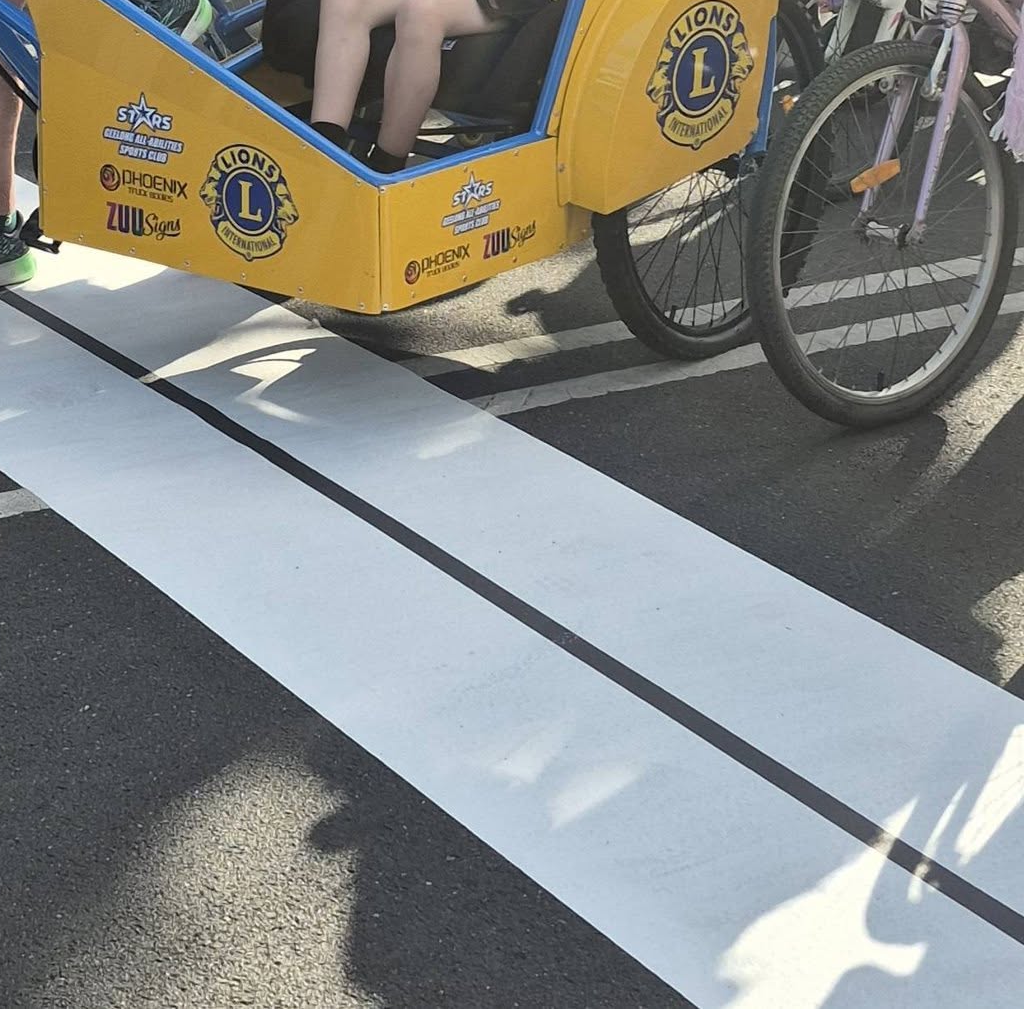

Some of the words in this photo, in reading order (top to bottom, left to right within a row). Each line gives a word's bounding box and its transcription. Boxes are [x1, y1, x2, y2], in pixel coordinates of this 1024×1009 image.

[674, 5, 735, 43] LIONS
[688, 47, 715, 99] L
[669, 107, 729, 138] INTERNATIONAL
[119, 145, 147, 159] SPORTS
[221, 149, 276, 179] LIONS
[122, 169, 188, 200] PHOENIX
[238, 180, 263, 222] L
[106, 201, 144, 237] ZUU
[143, 213, 181, 241] Signs
[222, 226, 277, 252] INTERNATIONAL
[483, 227, 510, 259] ZUU
[509, 220, 536, 249] Signs
[422, 244, 470, 274] PHOENIX
